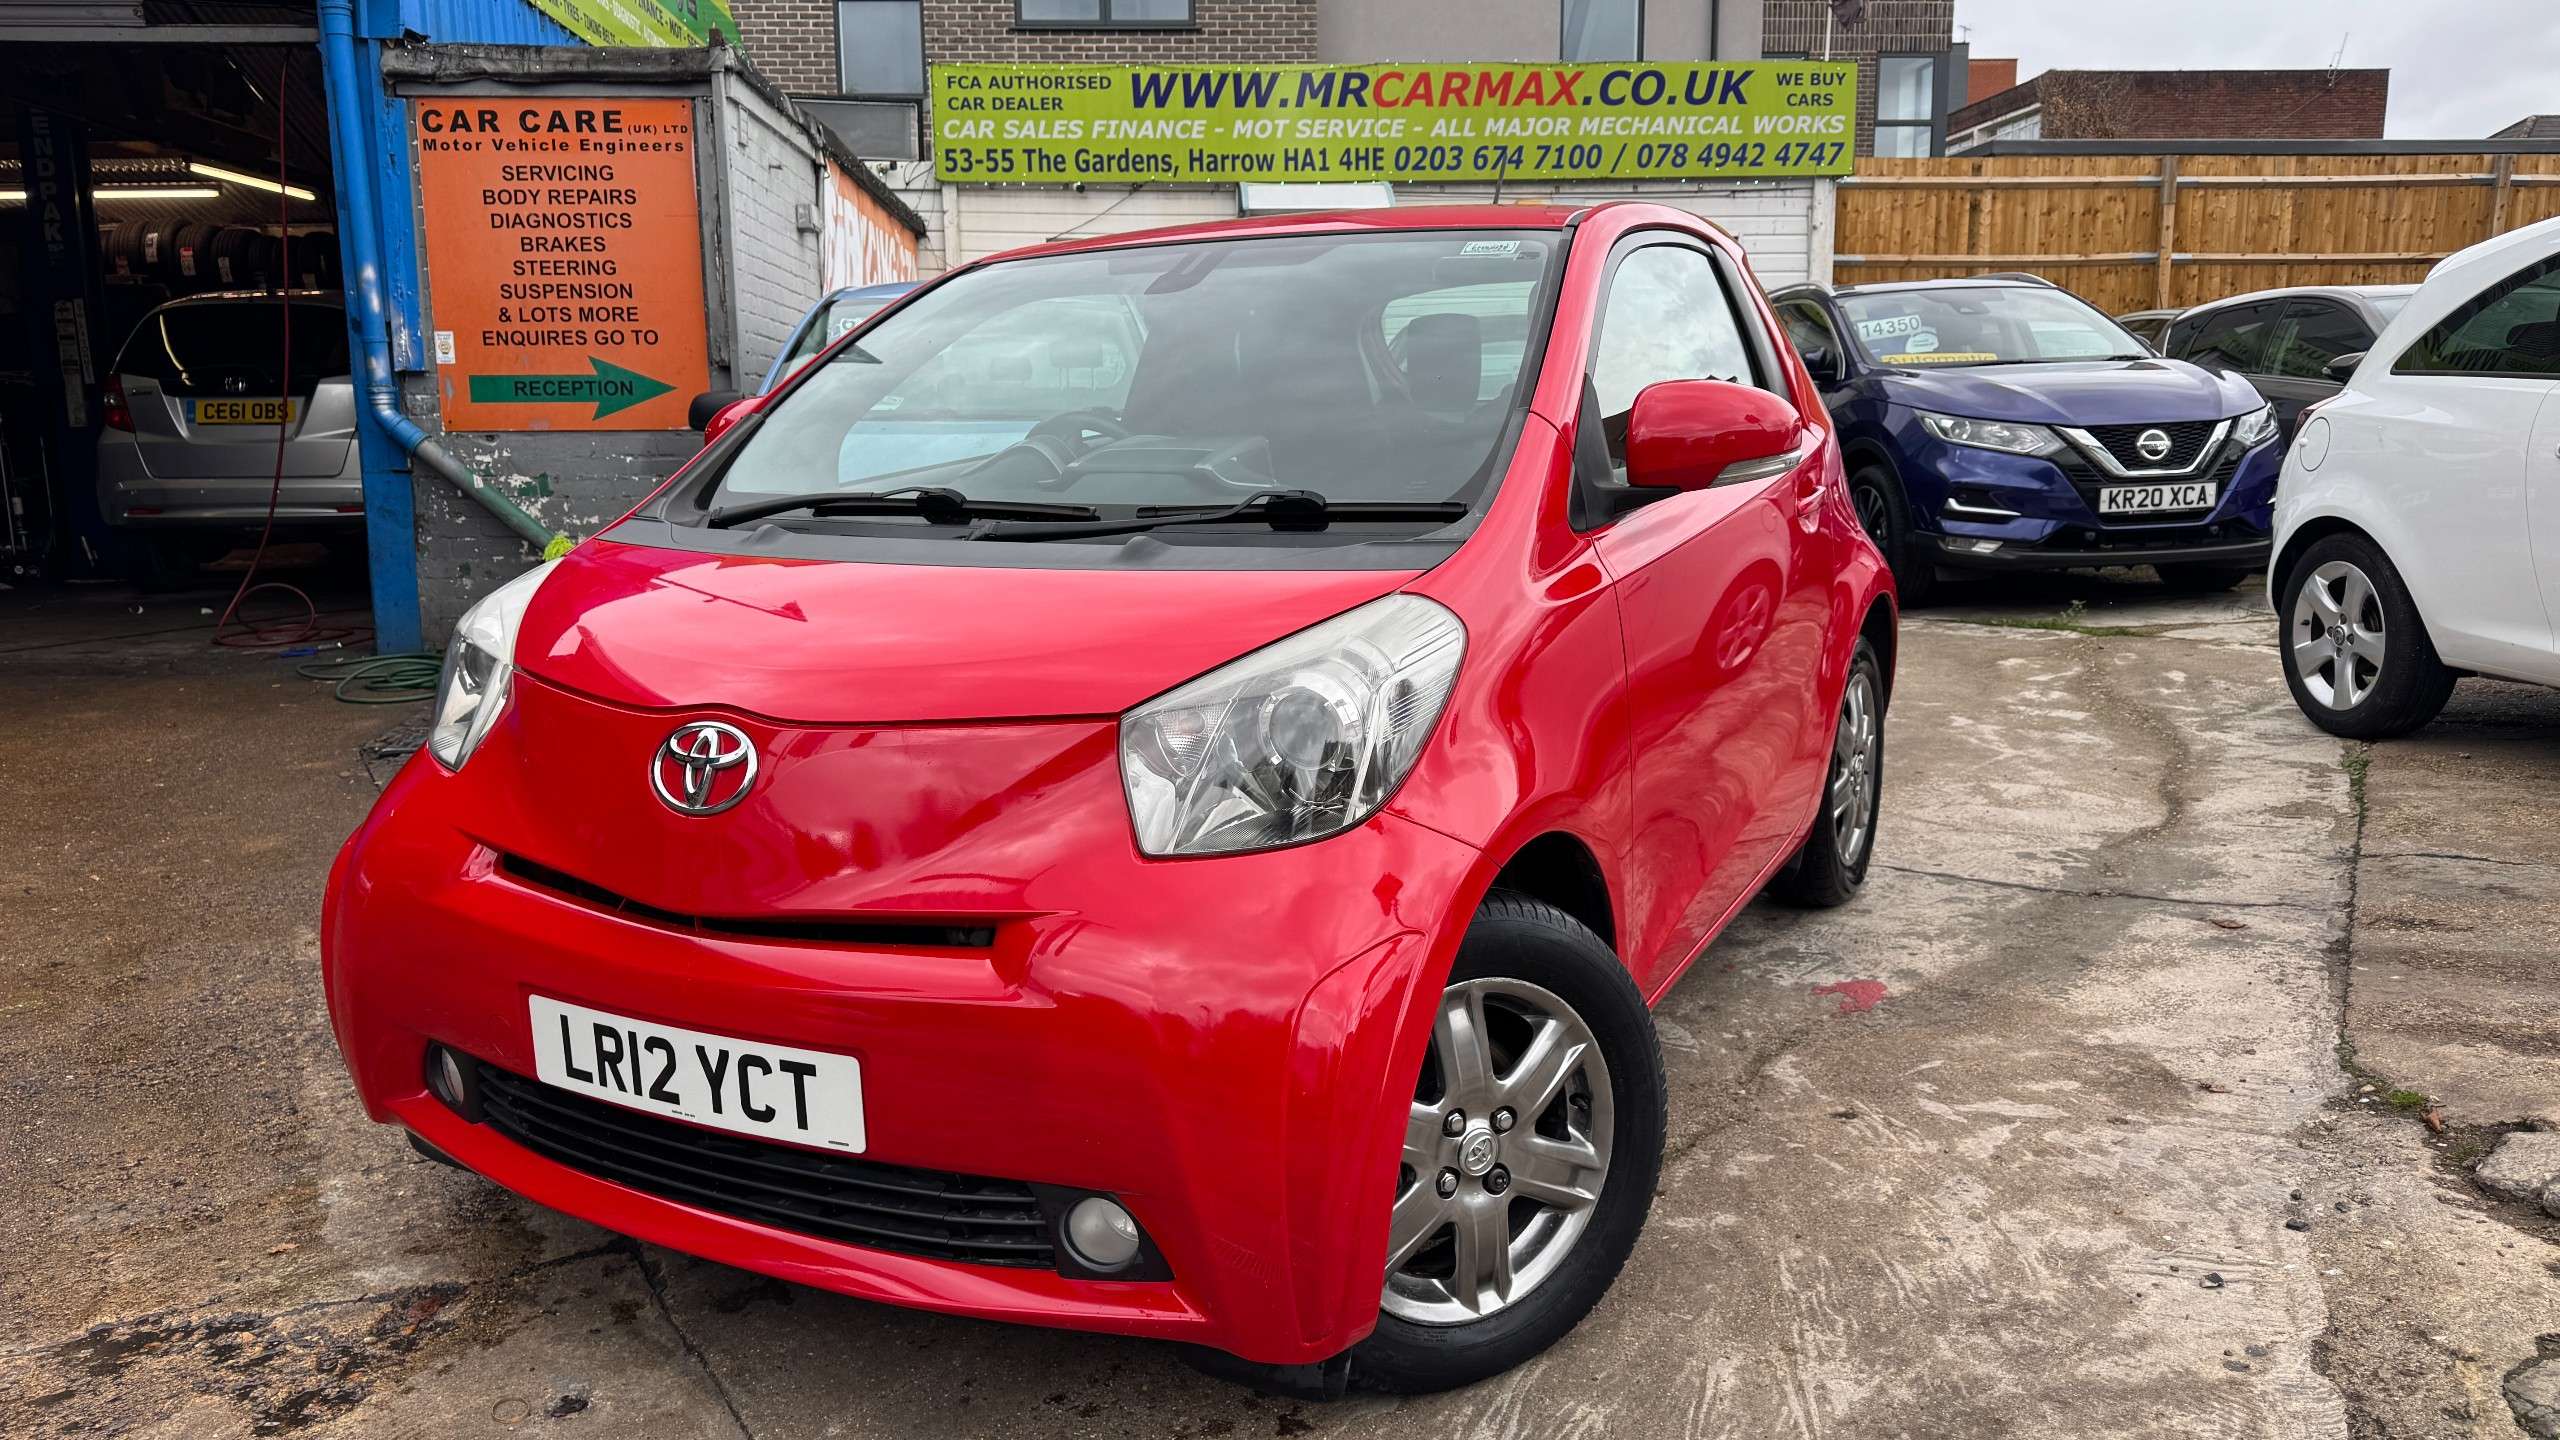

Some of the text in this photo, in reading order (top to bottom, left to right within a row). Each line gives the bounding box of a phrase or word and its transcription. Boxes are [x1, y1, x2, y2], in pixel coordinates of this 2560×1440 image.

[947, 75, 1112, 90] FCA AUTHORISED
[1776, 72, 1846, 87] WE BUY
[1132, 70, 1754, 109] WWW.MRCARMAX.CO.UK
[947, 96, 1064, 111] CAR DEALER
[1786, 92, 1834, 107] CARS
[421, 109, 689, 136] CAR CARE (UK) LTD
[943, 118, 996, 140] CAR
[1003, 118, 1084, 140] SALES
[1091, 118, 1207, 140] FINANCE
[1232, 118, 1291, 139] MOT
[1295, 117, 1406, 139] SERVICE
[1430, 116, 1476, 138] ALL
[1485, 116, 1572, 137] MAJOR
[1579, 115, 1743, 137] MECHANICAL
[1752, 114, 1846, 136] WORKS
[422, 138, 684, 155] Motor Vehicle Engineers
[944, 147, 1015, 173] 53-55
[1022, 147, 1067, 173] The
[1074, 147, 1180, 178] Gardens,
[1188, 147, 1275, 173] Harrow
[1284, 147, 1330, 172] HA1
[1339, 147, 1385, 172] 4HE
[1394, 145, 1464, 172] 0203
[1473, 144, 1524, 171] 674
[1534, 143, 1603, 171] 7100
[1636, 142, 1689, 169] 078
[1696, 142, 1766, 168] 4942
[1774, 141, 1845, 167] 4747
[501, 164, 614, 182] SERVICING
[482, 188, 637, 206] BODY REPAIRS
[490, 212, 633, 229] DIAGNOSTICS
[520, 236, 606, 253] BRAKES
[513, 259, 617, 276] STEERING
[500, 283, 633, 300] SUSPENSION
[498, 306, 640, 323] & LOTS MORE
[1861, 316, 1921, 338] 14350
[482, 329, 659, 347] ENQUIRES GO TO
[513, 380, 634, 397] RECEPTION
[203, 402, 289, 420] CE61 OBS
[2107, 485, 2209, 510] KR20 XCA
[559, 1013, 817, 1131] LR12 YCT
